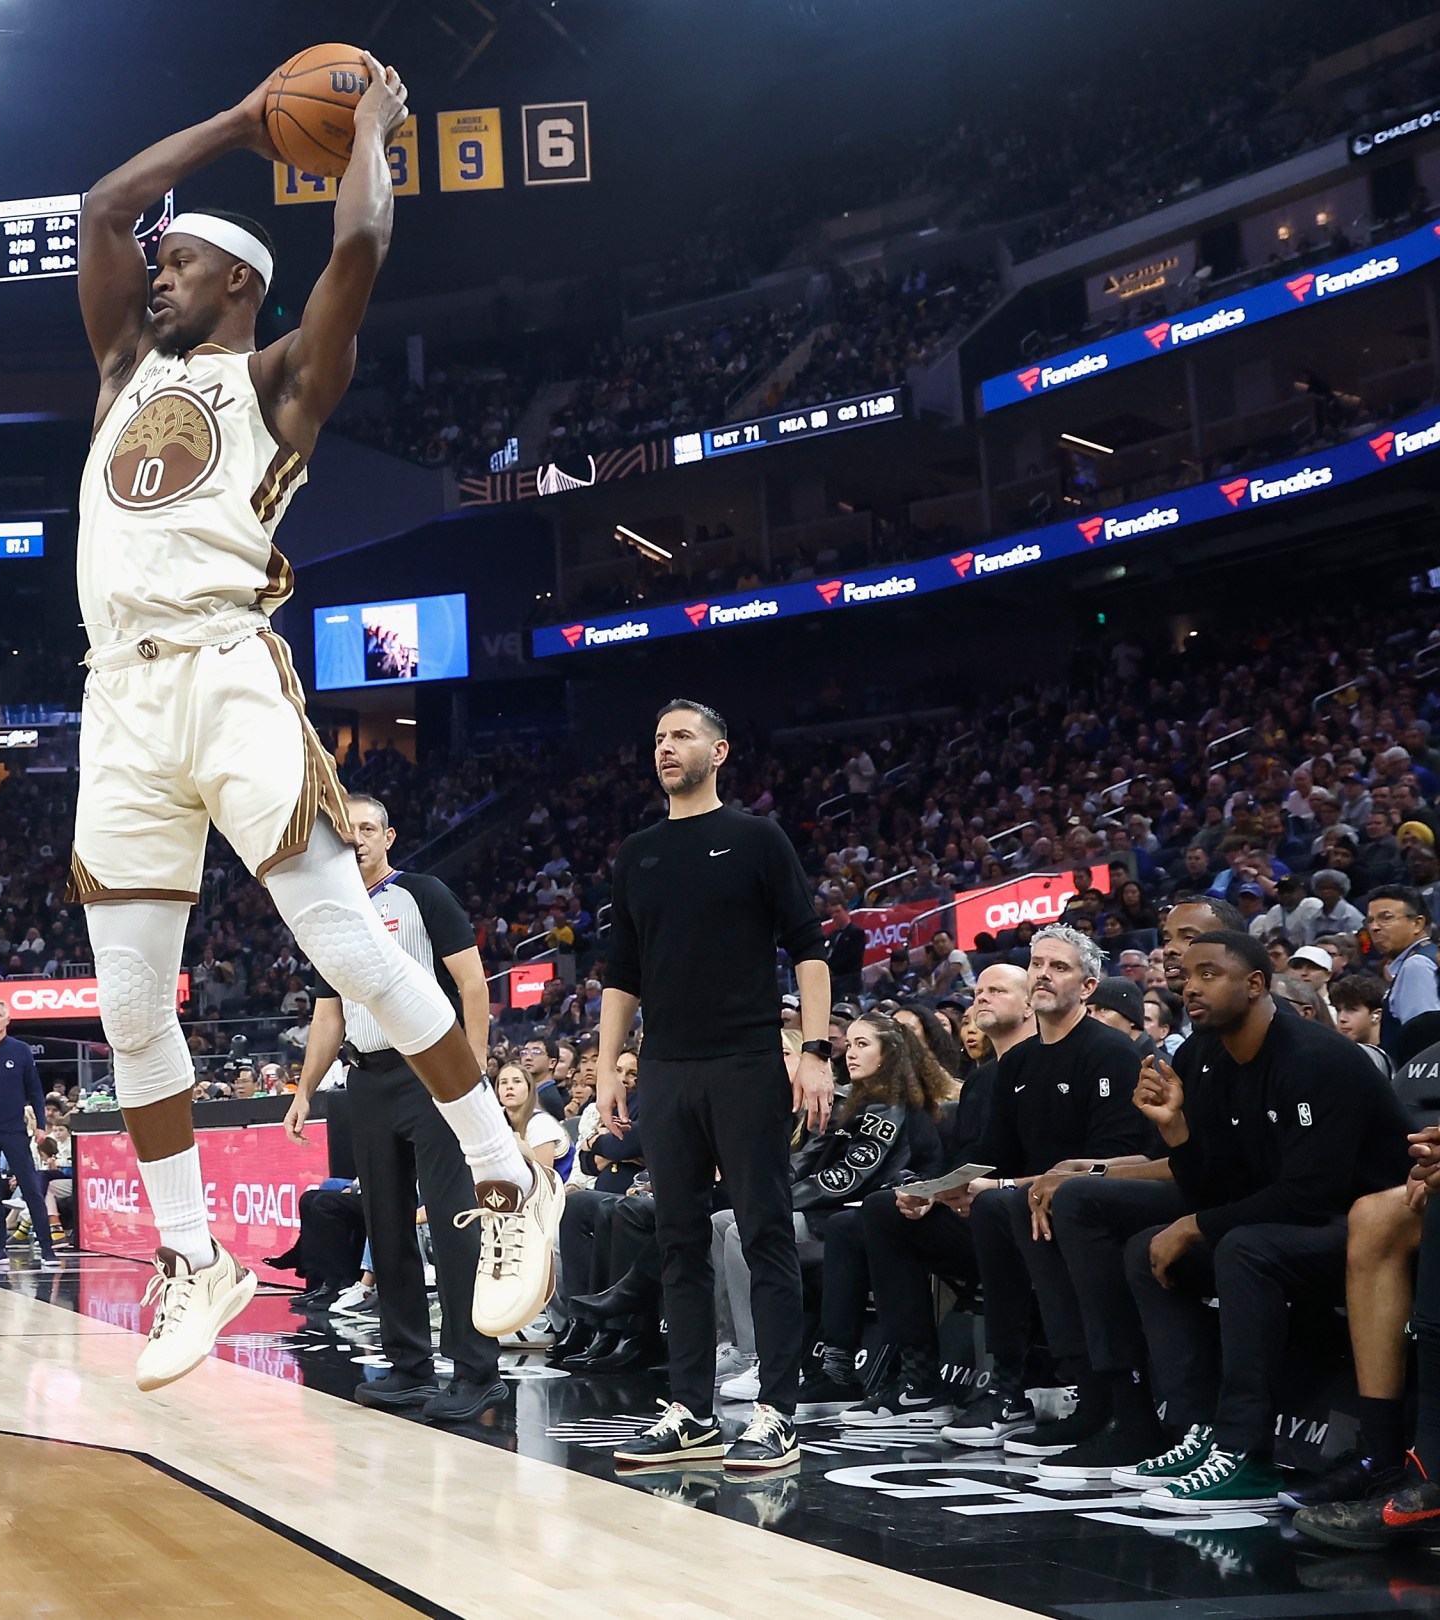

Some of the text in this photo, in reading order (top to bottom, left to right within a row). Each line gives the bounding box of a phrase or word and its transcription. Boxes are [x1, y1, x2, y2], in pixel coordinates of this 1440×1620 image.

[458, 140, 484, 180] 9
[536, 118, 575, 168] 6
[1314, 256, 1399, 297] Fanatics
[1171, 307, 1245, 345] Fanatics
[140, 364, 166, 384] The
[1041, 353, 1108, 389] Fanatics
[714, 430, 740, 447] DET
[744, 425, 760, 442] 71
[779, 417, 807, 433] MIA
[130, 457, 165, 497] 10
[1250, 465, 1333, 503] Fanatics
[1104, 507, 1179, 541] Fanatics
[974, 543, 1041, 575] Fanatics
[844, 575, 916, 604] Fanatics
[710, 599, 779, 626] Fanatics
[584, 620, 650, 646] Fanatics
[860, 1112, 897, 1142] 78
[87, 1177, 140, 1214] ORACLE
